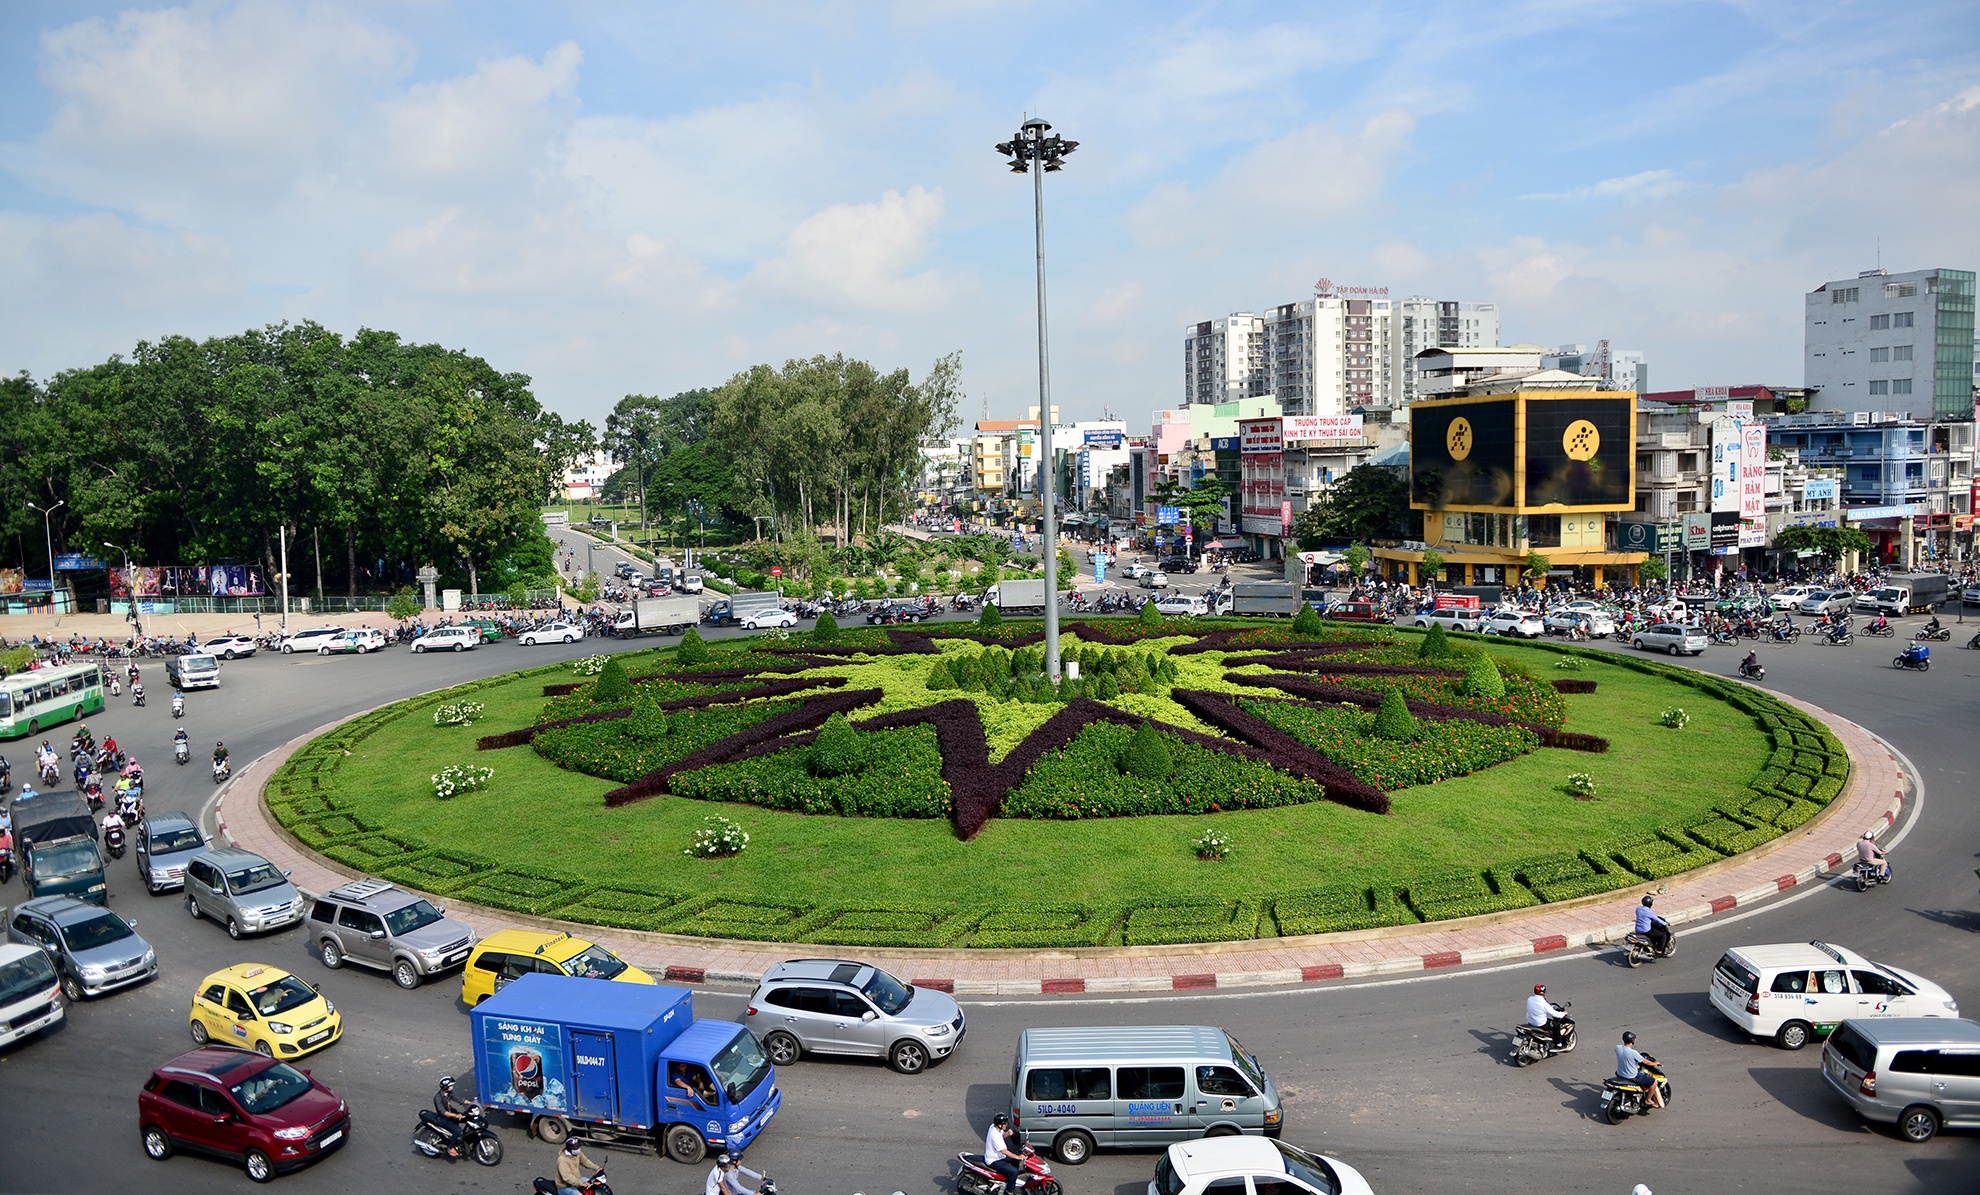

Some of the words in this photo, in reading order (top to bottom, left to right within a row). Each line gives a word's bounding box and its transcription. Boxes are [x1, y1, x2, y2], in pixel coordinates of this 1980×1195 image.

[1320, 418, 1339, 426] TRUNG
[1284, 429, 1298, 437] KINH
[1218, 439, 1229, 449] ACB
[1818, 489, 1832, 497] ANH
[518, 1080, 539, 1088] pepsi
